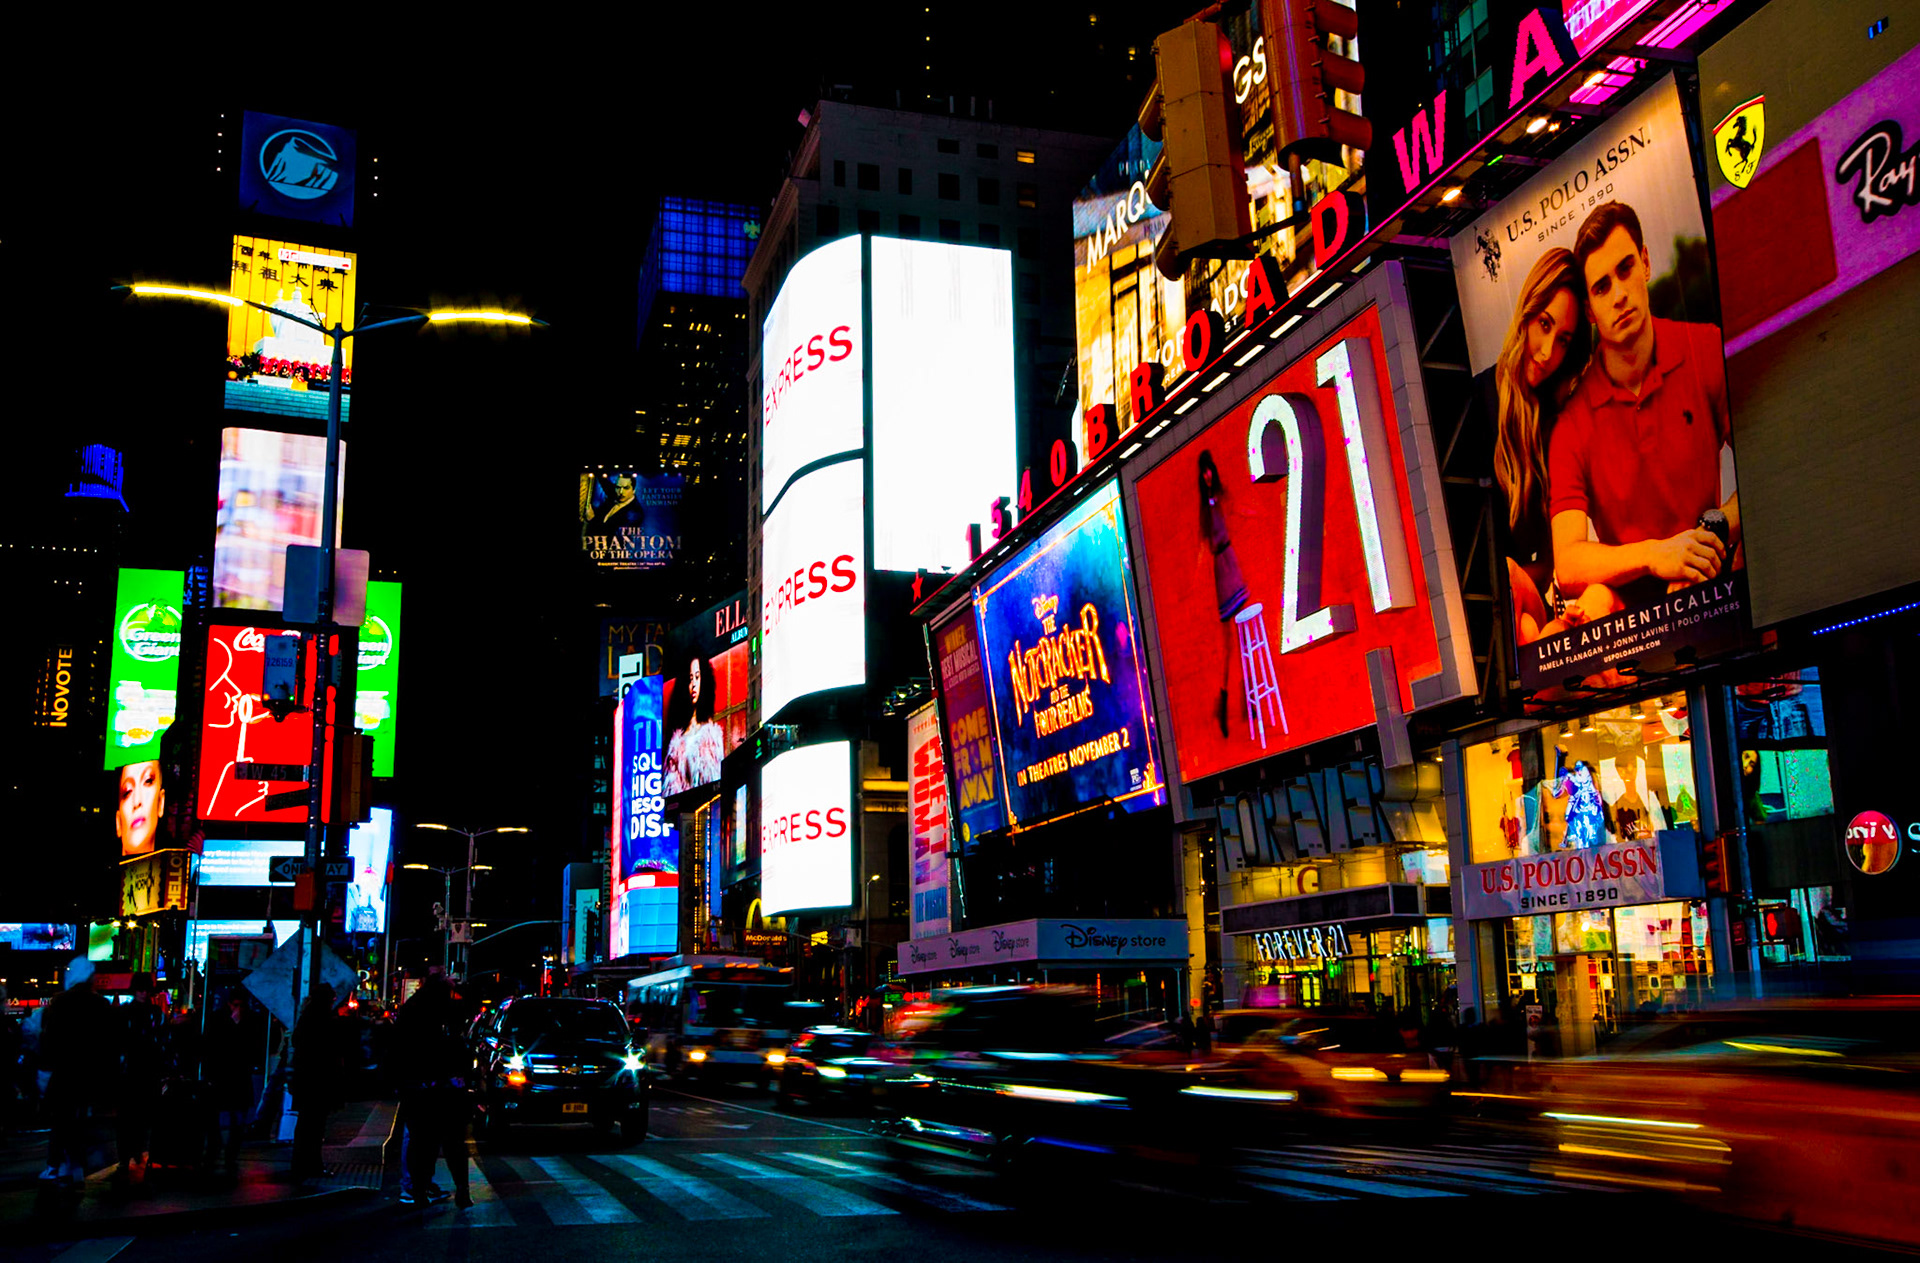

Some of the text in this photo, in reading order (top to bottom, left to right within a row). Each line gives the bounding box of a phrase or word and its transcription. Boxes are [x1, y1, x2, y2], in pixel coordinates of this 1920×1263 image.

[1506, 127, 1651, 242] U.S. POLO ASSN.
[1839, 131, 1918, 214] Ray
[1086, 170, 1153, 275] MARQ
[1086, 8, 1564, 460] BROADWA
[1537, 183, 1614, 242] SINCE 1890
[765, 325, 853, 428] EXPRESS
[1247, 338, 1394, 652] 21
[581, 535, 682, 551] PHANTOM
[590, 550, 674, 560] OF THE OPERA
[619, 526, 644, 536] THE
[715, 600, 747, 638] ELL
[765, 554, 857, 636] EXPRESS
[1042, 614, 1056, 635] THE
[1538, 580, 1735, 660] LIVE AUTHENTICALLY
[1538, 655, 1564, 673] PAMELA
[1565, 645, 1603, 665] FLANAGAN
[1612, 635, 1639, 650] JONNY
[1641, 623, 1670, 639] LAVINE
[1678, 614, 1701, 628] POLO
[1702, 600, 1740, 620] PLAYERS
[1008, 603, 1110, 727] NUTCRACKER
[1603, 639, 1661, 663] USPOLOASSN.COM
[951, 706, 988, 749] COME
[1034, 685, 1093, 738] FOUR REALMS
[1017, 728, 1130, 787] IN THEATRES NOVEMBER 2
[960, 767, 994, 810] AWAY
[763, 807, 847, 853] EXPRESS
[1480, 846, 1657, 894] U.S. POLO ASSN
[1521, 887, 1618, 909] SINCE 1890
[1015, 937, 1030, 950] store
[1130, 934, 1166, 948] store
[1255, 925, 1348, 961] FOREVER 21
